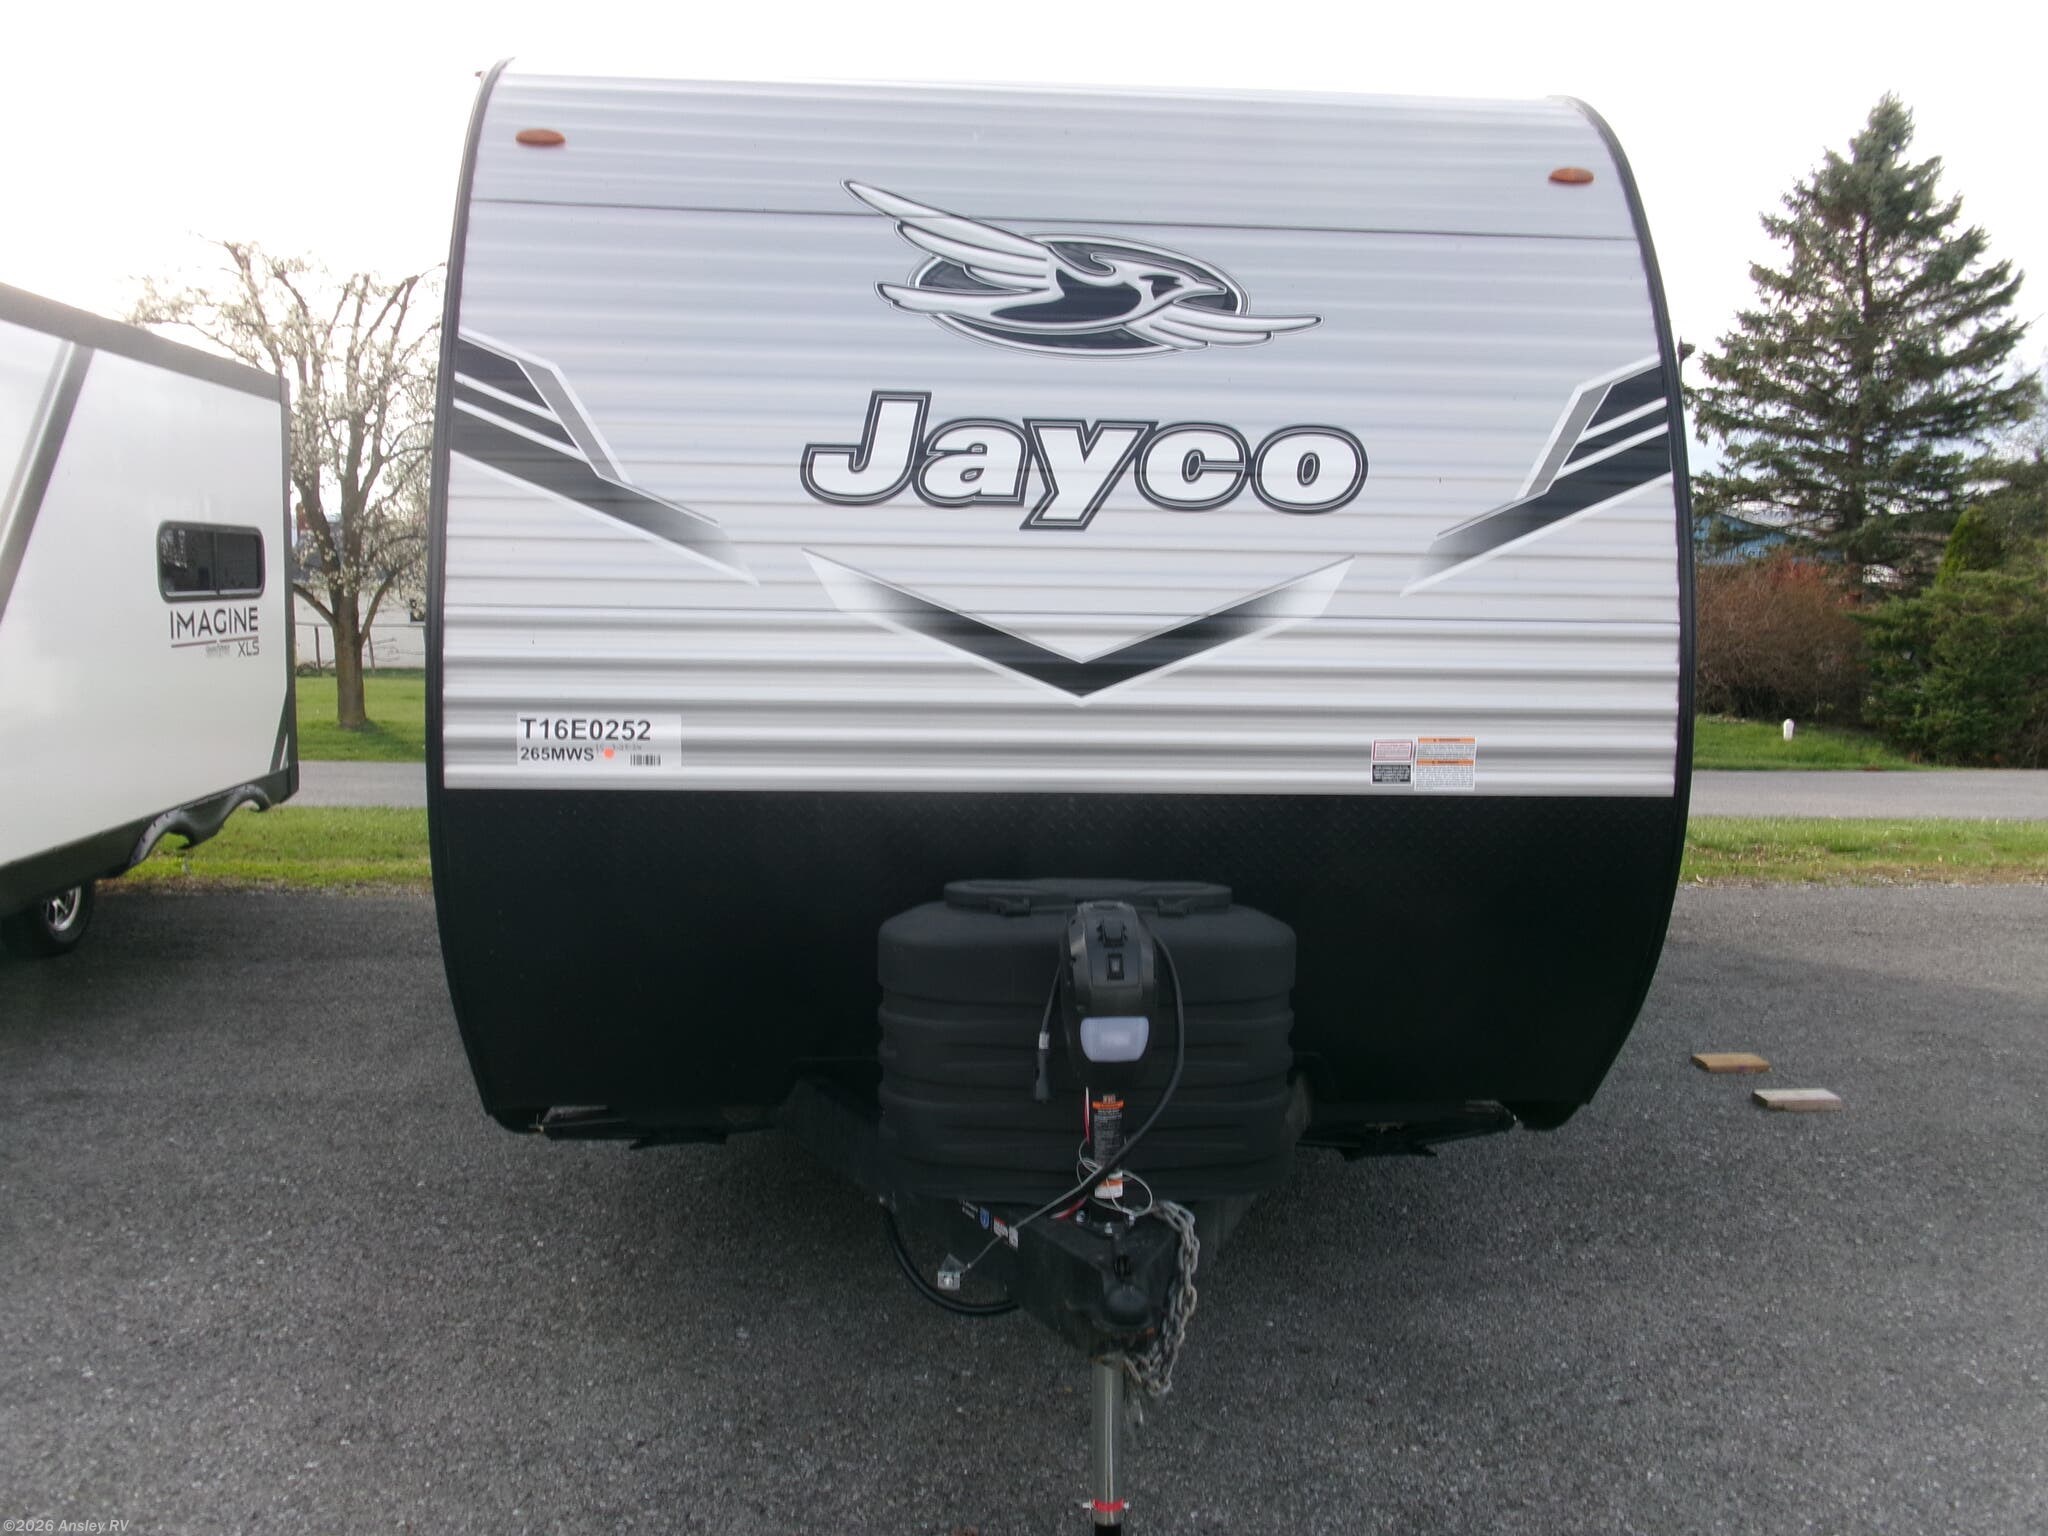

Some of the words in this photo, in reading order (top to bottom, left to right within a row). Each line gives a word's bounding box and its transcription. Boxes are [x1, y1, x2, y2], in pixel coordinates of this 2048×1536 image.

[800, 389, 1368, 531] Jayco
[169, 606, 259, 640] IMAGINE
[237, 640, 260, 657] XLS
[520, 717, 652, 741] T16E0252
[520, 746, 595, 762] 265MWS
